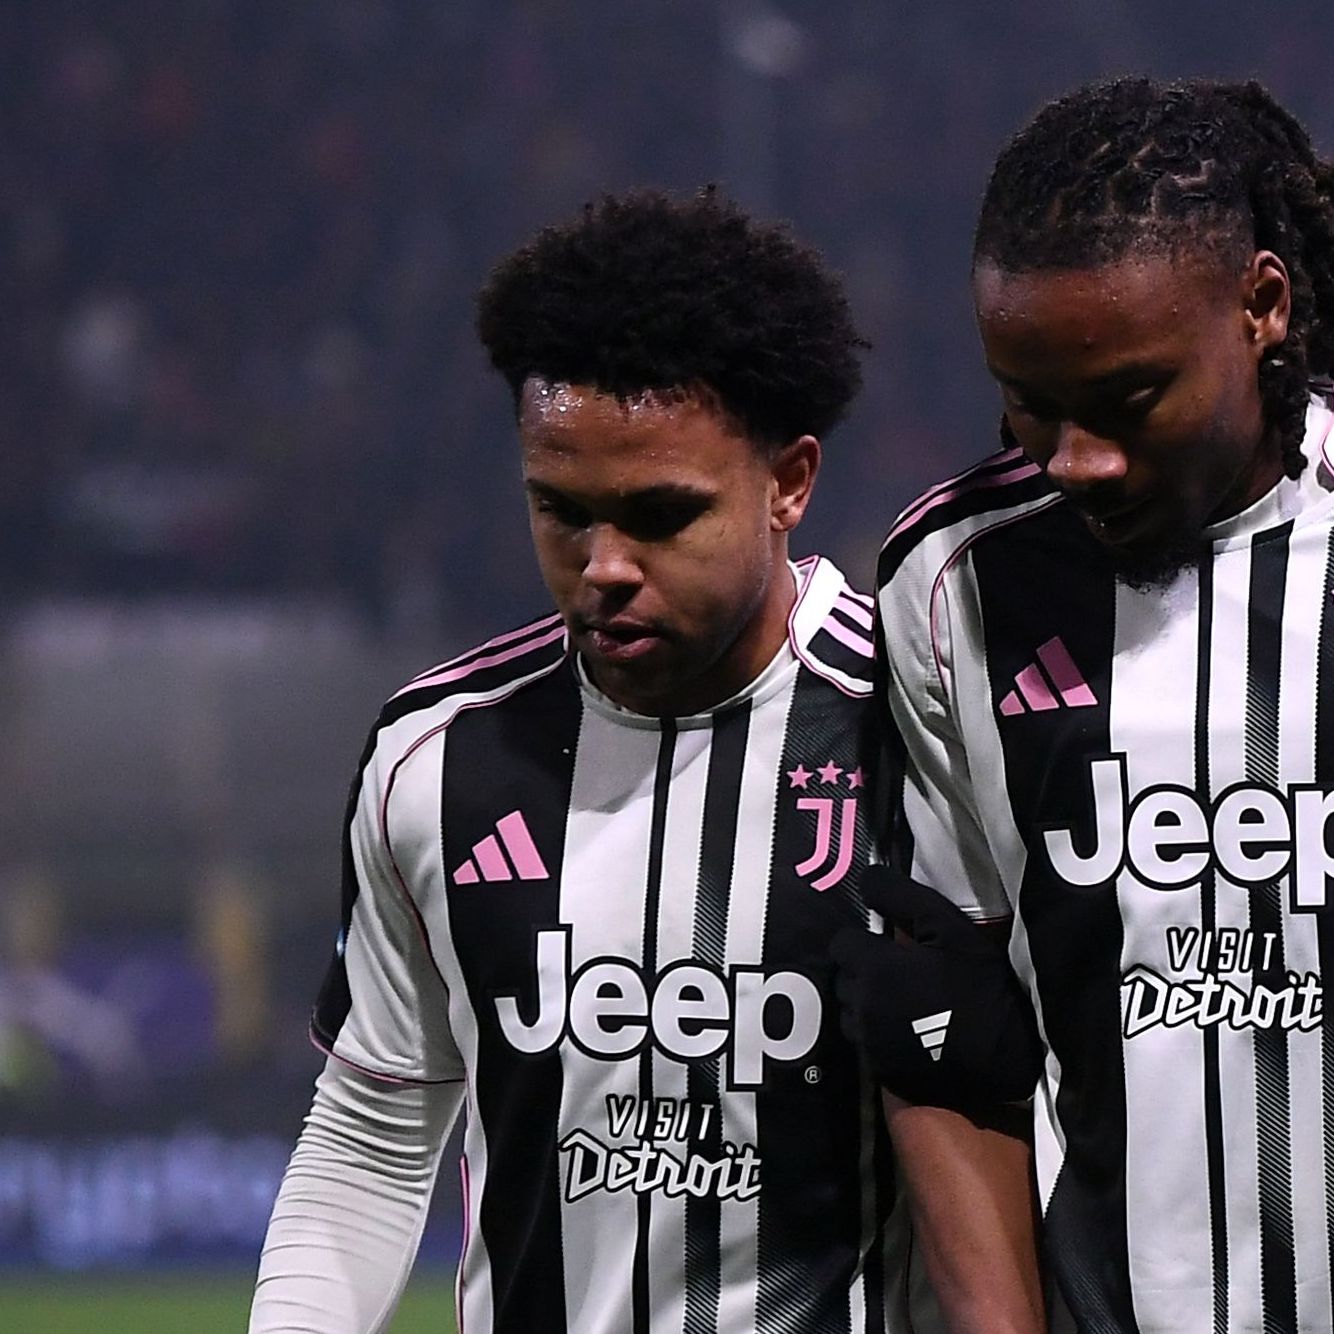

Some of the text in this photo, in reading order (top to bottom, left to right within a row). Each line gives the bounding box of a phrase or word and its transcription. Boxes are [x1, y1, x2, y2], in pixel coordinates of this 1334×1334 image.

[1168, 928, 1277, 972] VISIT
[494, 931, 822, 1085] Jeep
[1123, 965, 1333, 1037] Detroit
[606, 1096, 714, 1141] VISIT
[561, 1130, 763, 1201] Detroit
